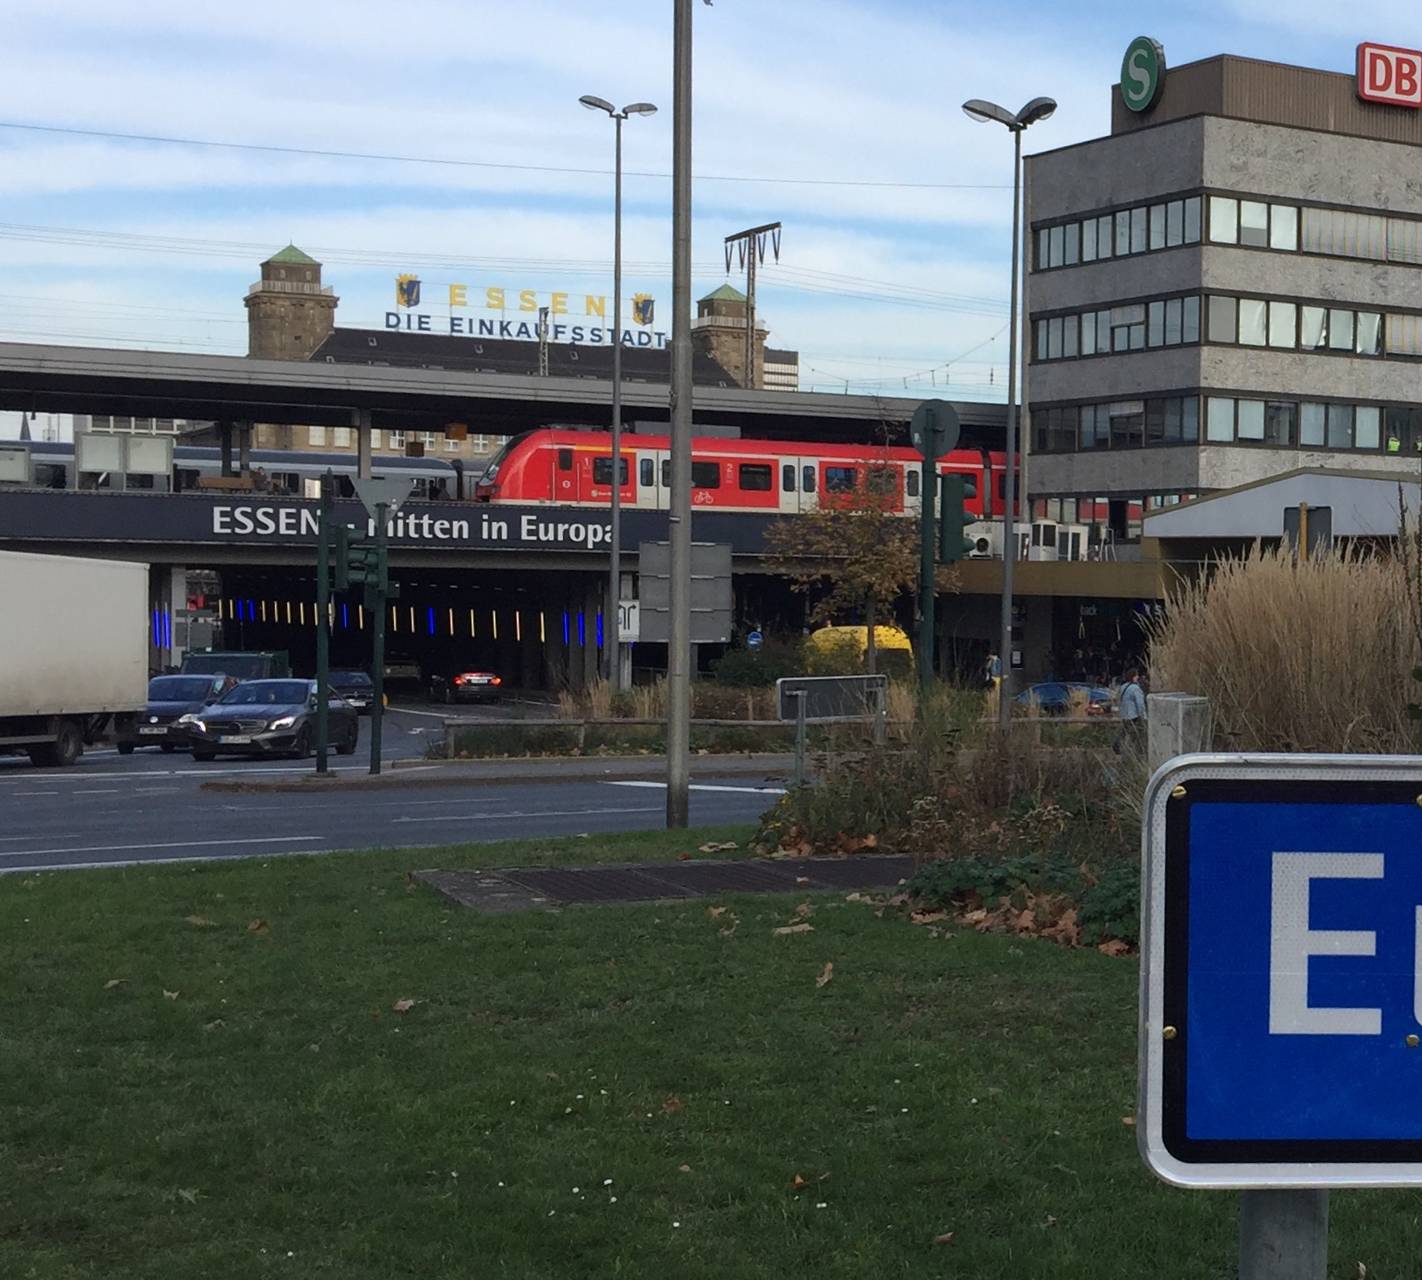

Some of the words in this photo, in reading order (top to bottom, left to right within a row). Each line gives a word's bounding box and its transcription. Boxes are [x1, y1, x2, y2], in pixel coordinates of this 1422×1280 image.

[1127, 48, 1150, 101] S
[1368, 52, 1418, 97] DB
[448, 283, 606, 318] ESSEN
[384, 311, 431, 332] DIE
[213, 506, 320, 535] ESSEN
[482, 514, 508, 540] in
